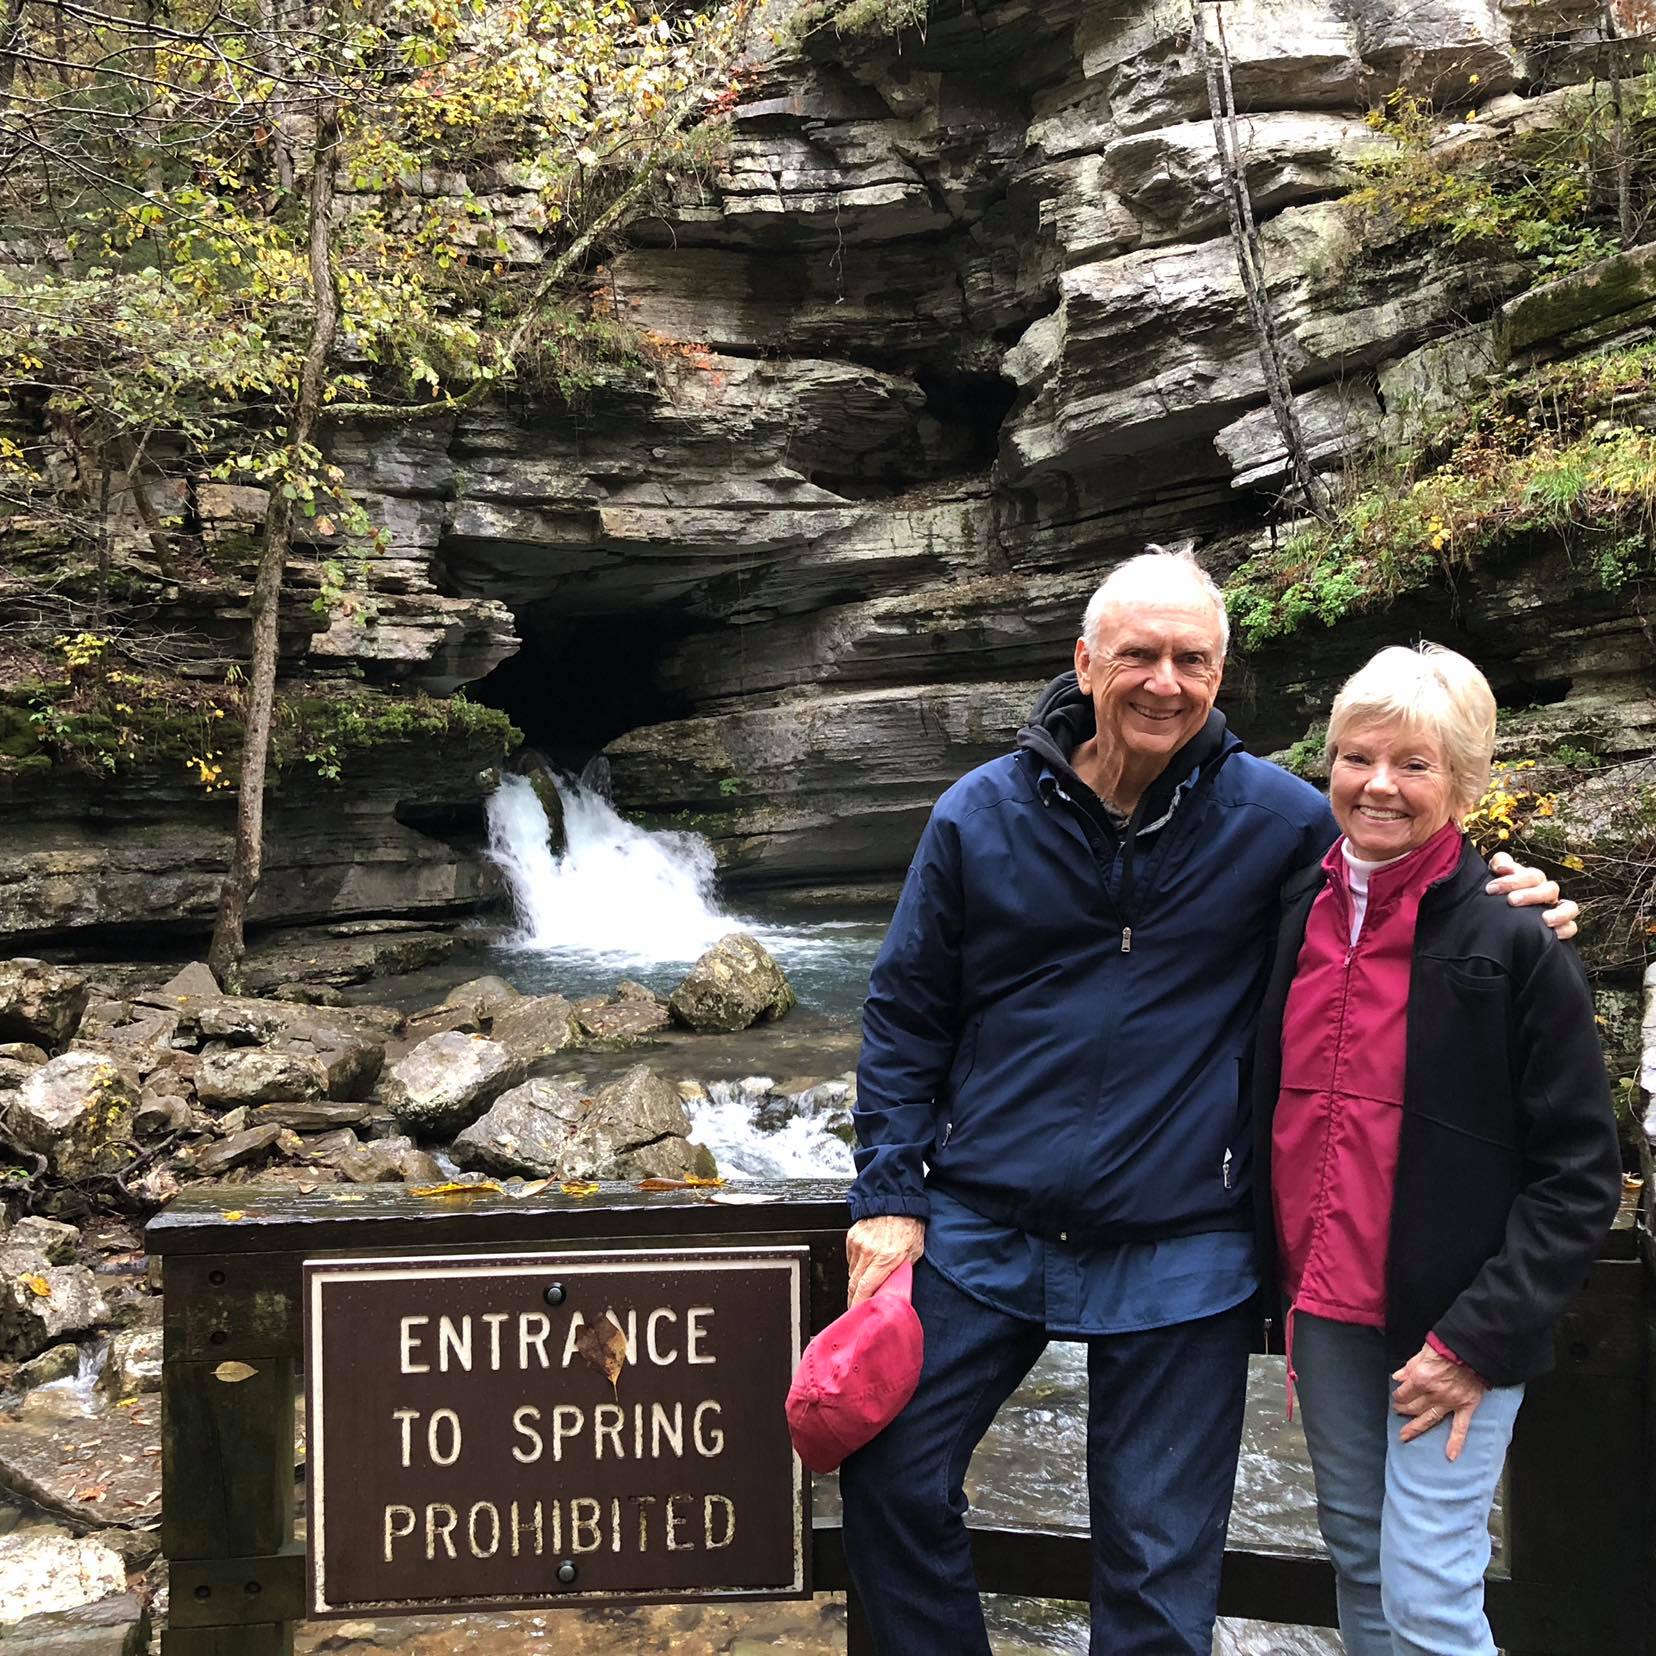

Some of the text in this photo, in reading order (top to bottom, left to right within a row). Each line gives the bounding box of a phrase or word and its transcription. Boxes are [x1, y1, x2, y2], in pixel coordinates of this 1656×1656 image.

[393, 1400, 725, 1467] TO SPRING
[384, 1494, 736, 1562] PROHIBITED
